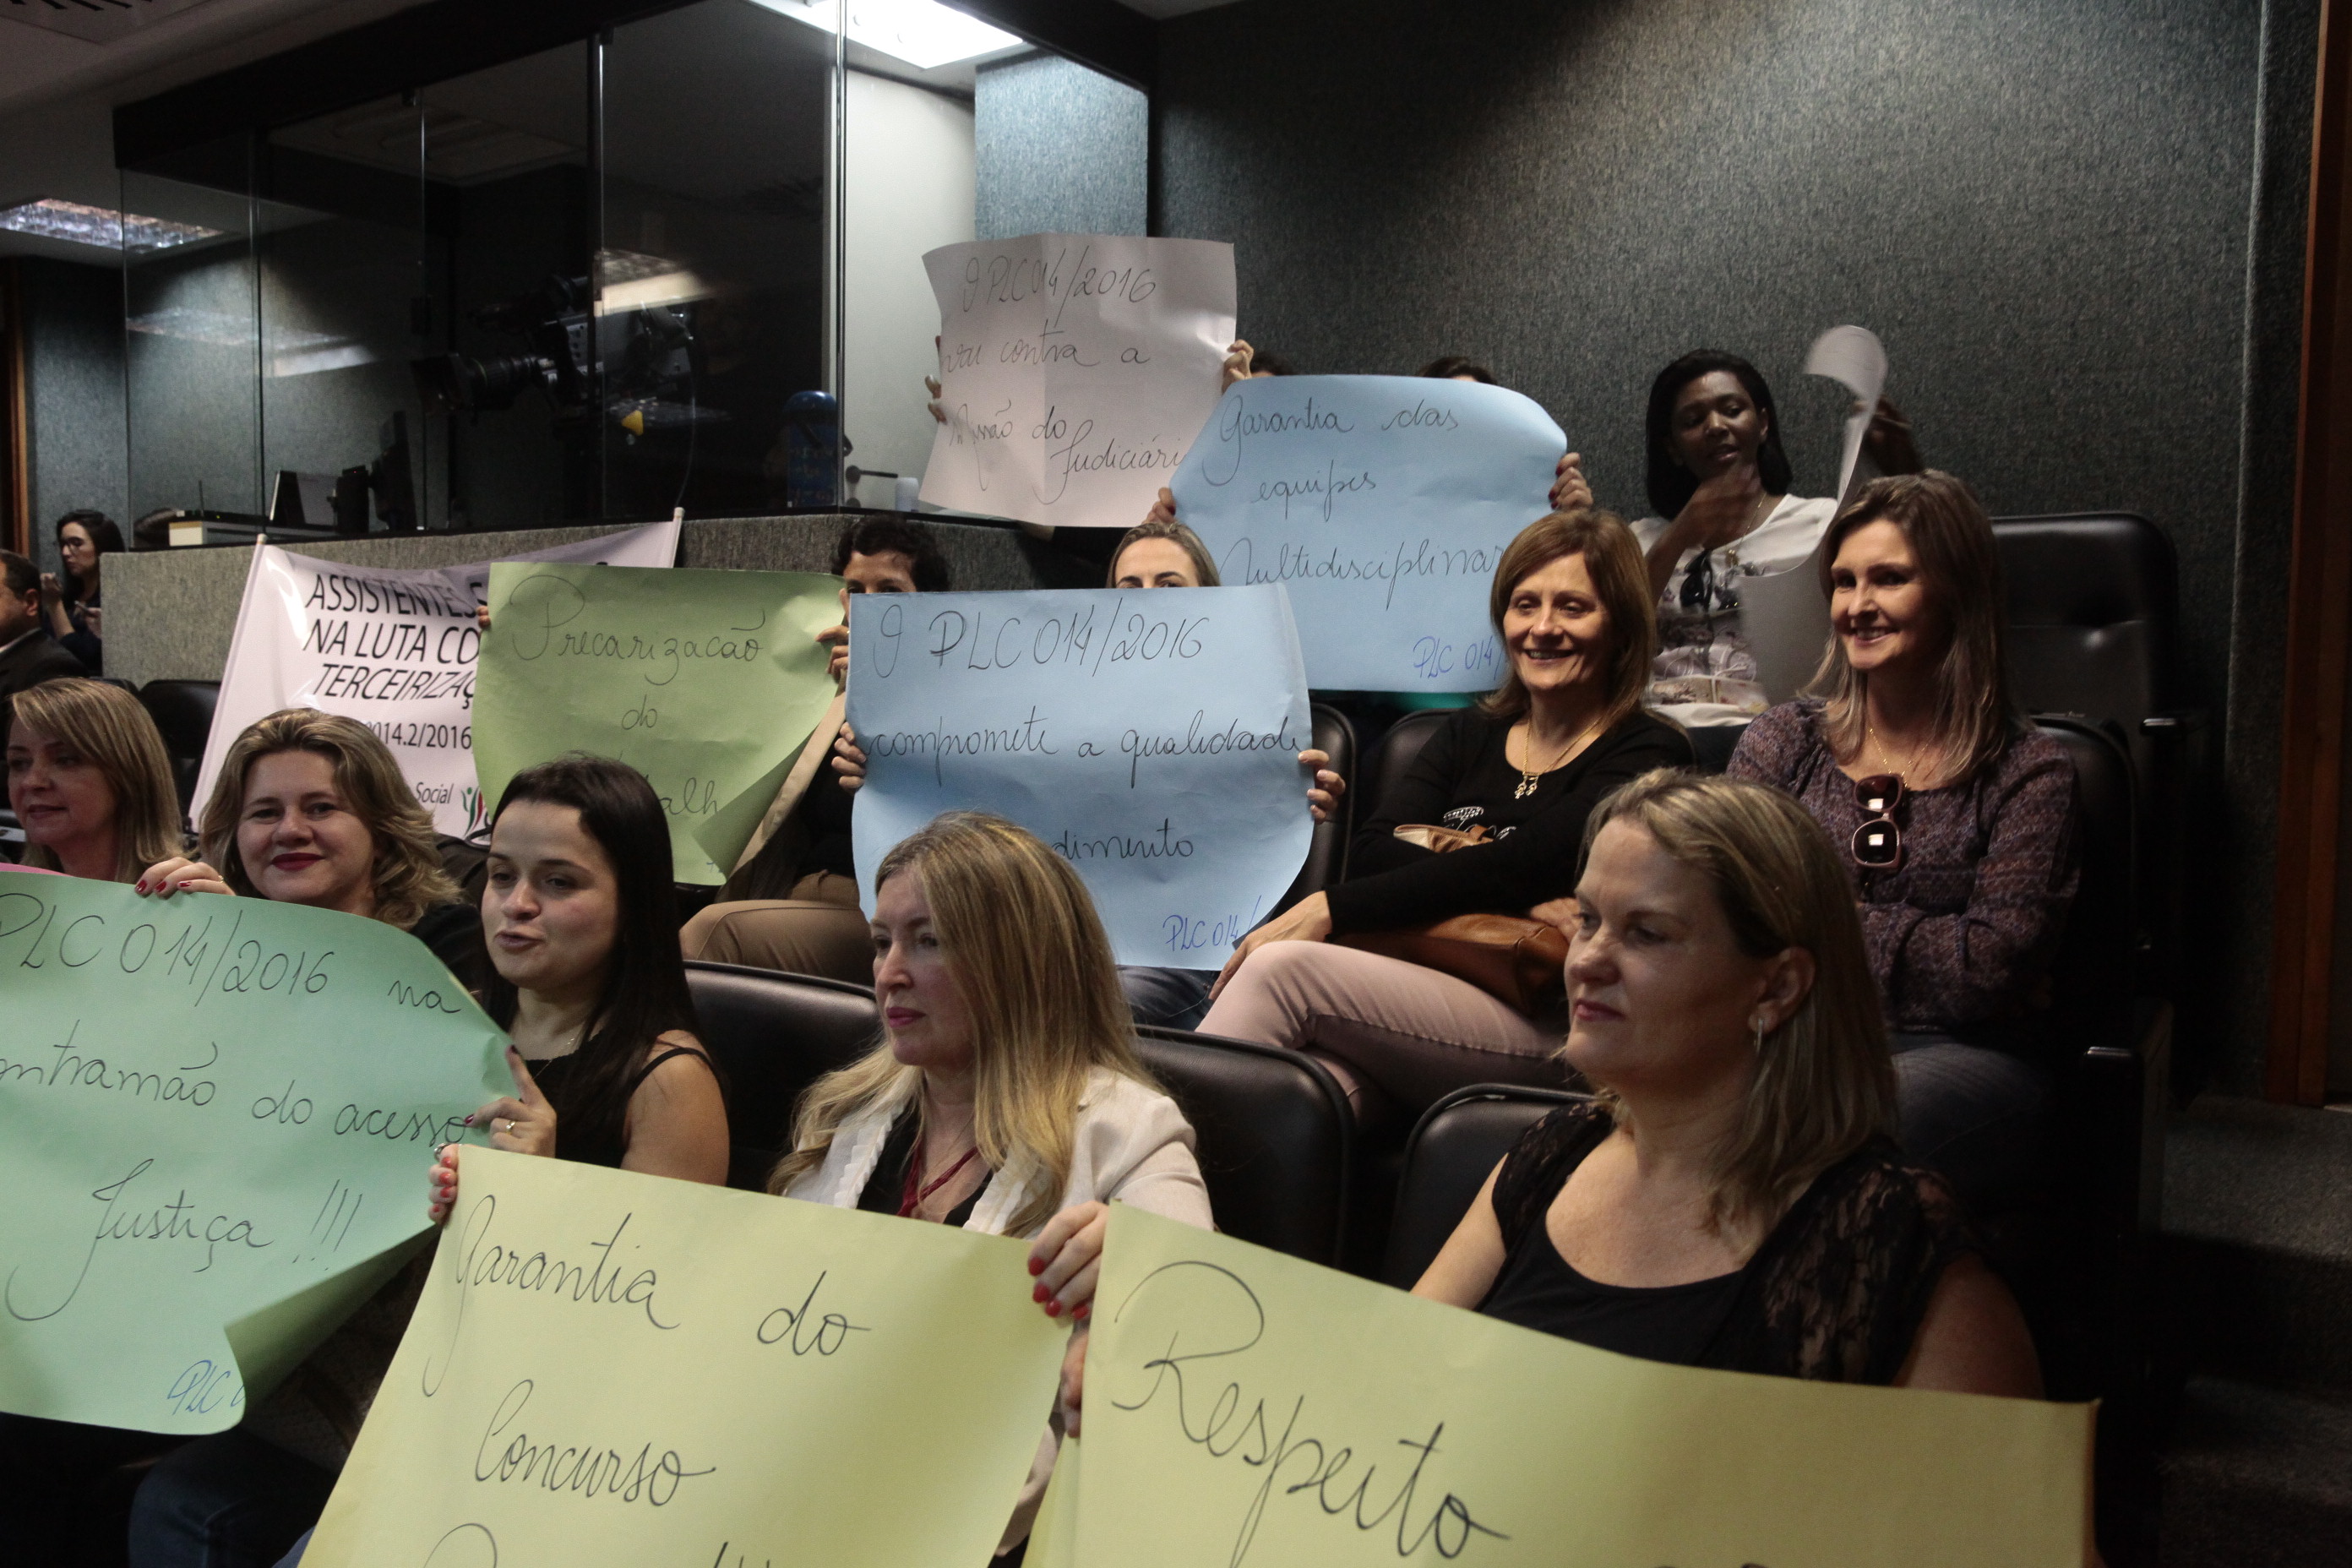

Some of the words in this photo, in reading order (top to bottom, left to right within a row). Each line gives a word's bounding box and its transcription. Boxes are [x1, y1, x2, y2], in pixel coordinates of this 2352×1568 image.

[1000, 318, 1100, 367] contra
[1120, 346, 1150, 365] a
[1032, 406, 1067, 439] do
[1201, 394, 1355, 487] Garantia
[1381, 399, 1459, 431] das
[1032, 419, 1187, 505] Judiciári
[1251, 459, 1377, 523] equipes
[305, 573, 477, 618] ASSISTENTES
[1218, 536, 1504, 612] Multidisciplinar
[302, 618, 349, 656] NA
[354, 622, 427, 662] LUTA
[928, 609, 1021, 671] PLC
[1032, 596, 1211, 678] 014/2016
[1413, 635, 1455, 679] PLC
[1464, 634, 1505, 681] 014/
[312, 662, 476, 709] TERCEIRIZAÇ
[621, 694, 658, 731] do
[863, 705, 1058, 787] compromete
[1077, 739, 1106, 758] a
[1119, 709, 1303, 789] qualidade
[415, 781, 455, 804] Social
[1053, 817, 1194, 860] dimento
[1162, 914, 1207, 952] PLC
[1211, 894, 1262, 947] 014/
[120, 909, 335, 1007] 014/2016
[388, 978, 462, 1015] na
[0, 1018, 219, 1107] ntramão
[252, 1078, 313, 1125] do
[334, 1102, 470, 1146] acesso
[4, 1157, 275, 1321] Justiça
[422, 1194, 682, 1397] Garantia
[756, 1269, 873, 1356] do
[166, 1358, 231, 1416] PLC
[1110, 1259, 1512, 1568] Respeito
[474, 1379, 716, 1507] Concurso
